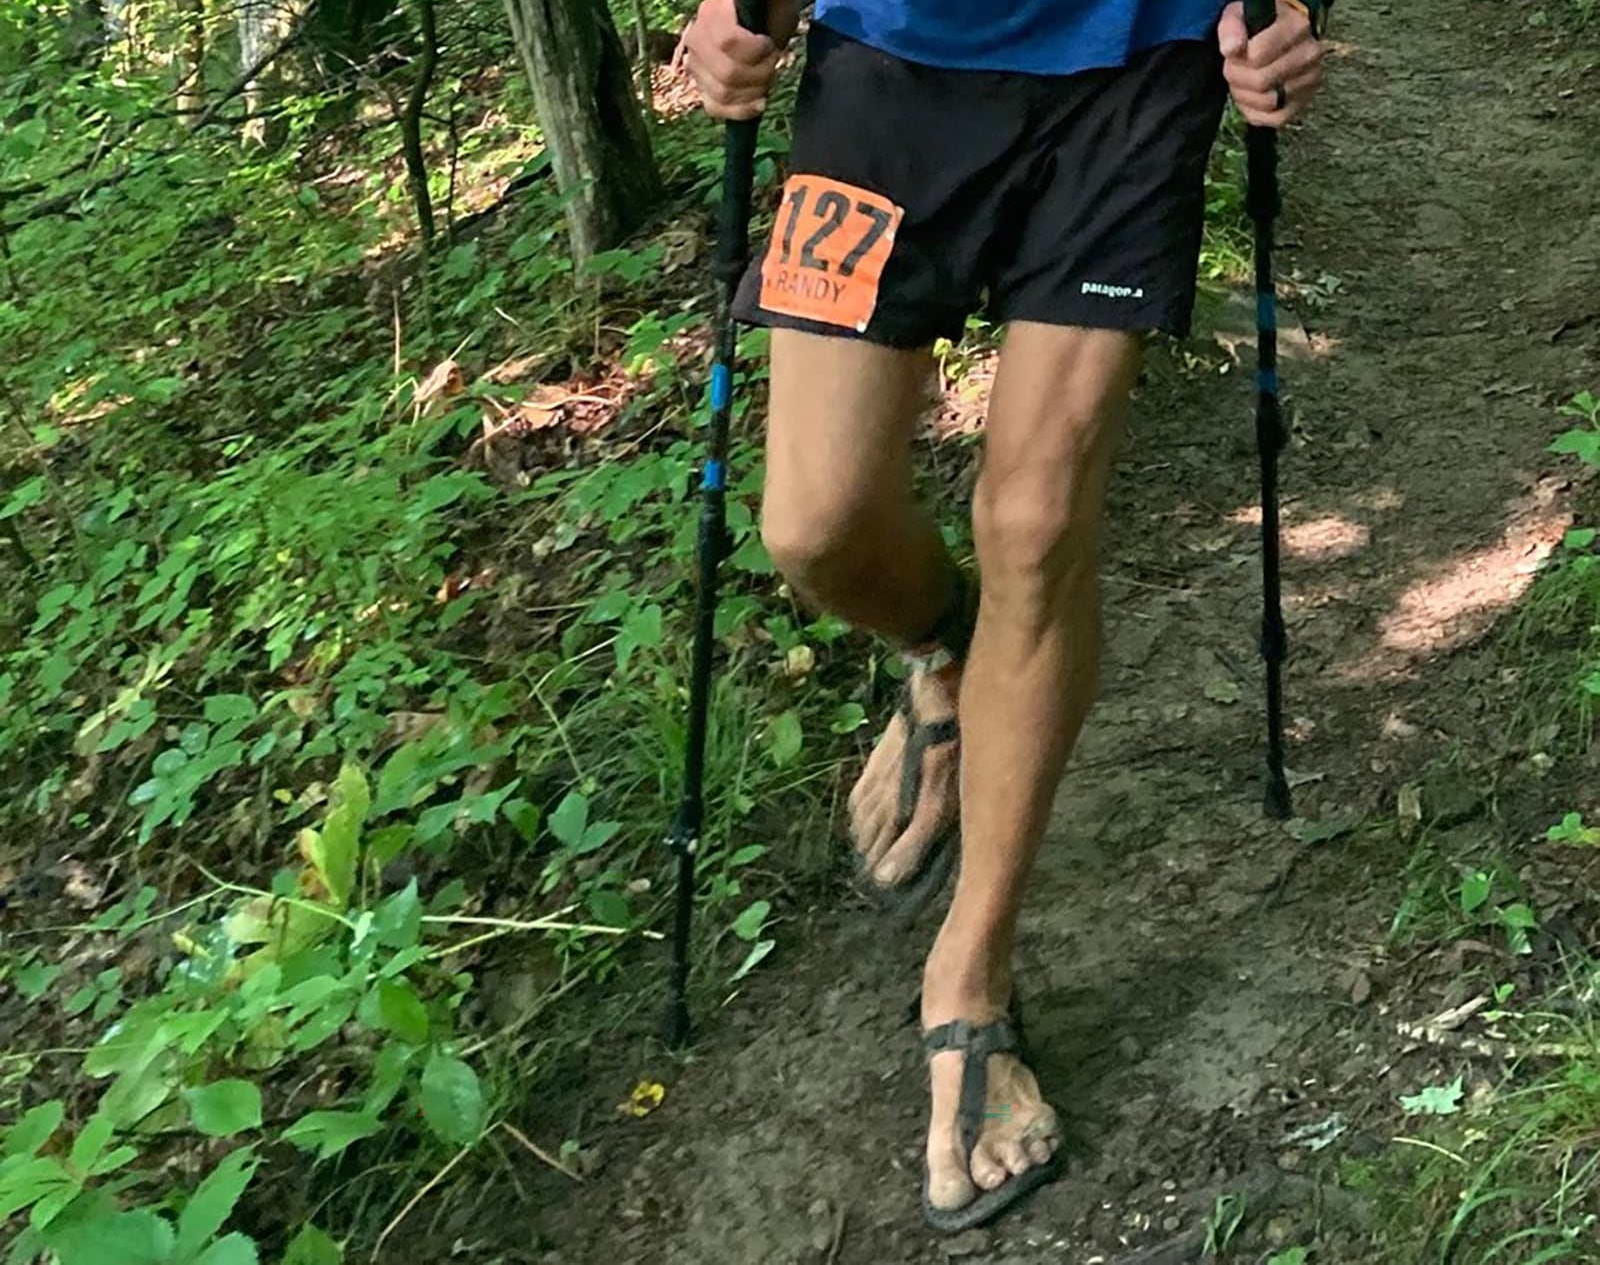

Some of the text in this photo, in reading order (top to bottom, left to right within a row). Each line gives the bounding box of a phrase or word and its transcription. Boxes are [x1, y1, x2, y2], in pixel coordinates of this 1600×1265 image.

[779, 185, 893, 277] 127
[775, 269, 847, 304] RANDY
[1081, 281, 1144, 298] patagona
